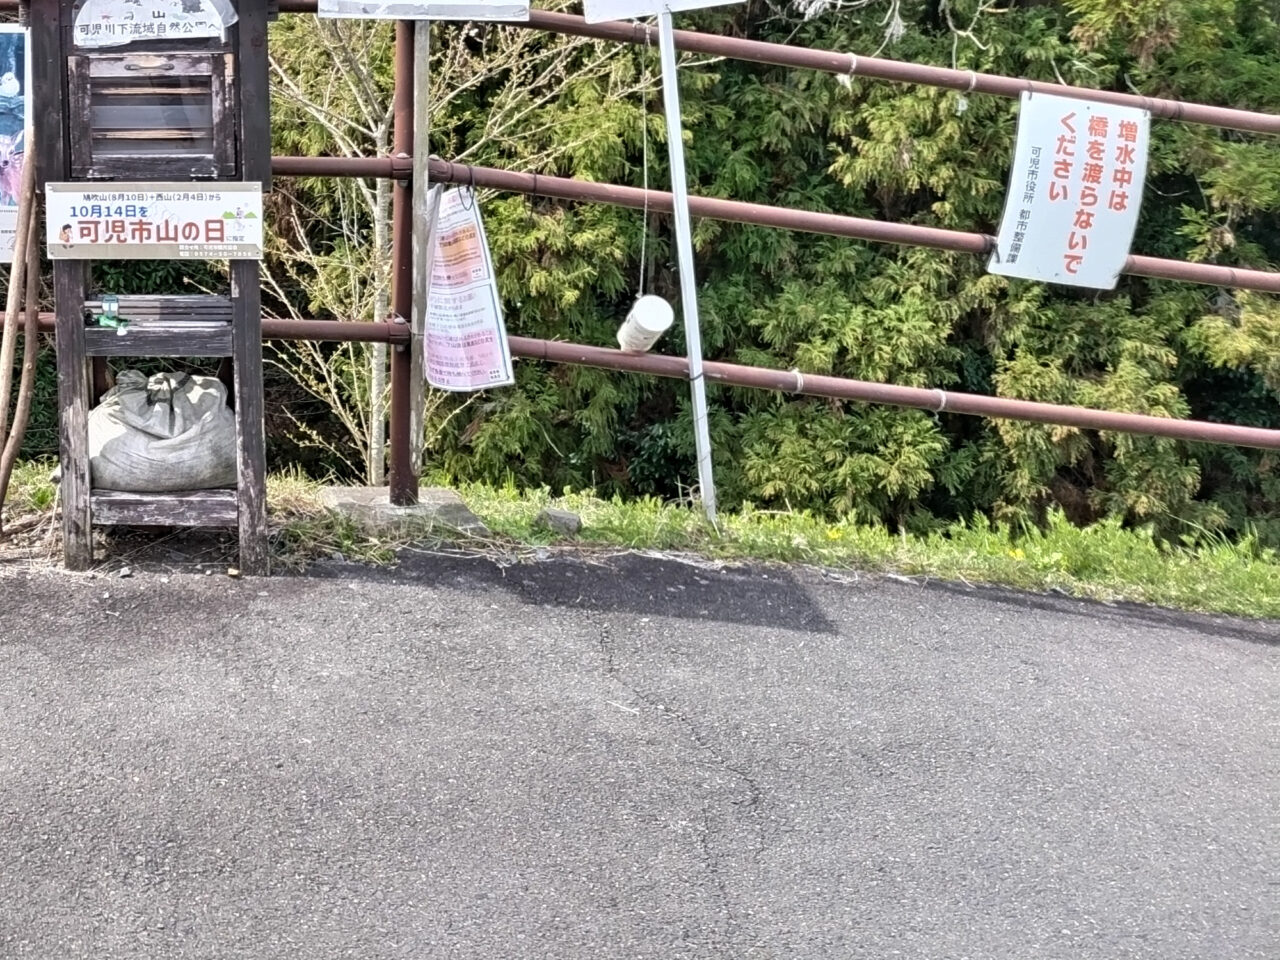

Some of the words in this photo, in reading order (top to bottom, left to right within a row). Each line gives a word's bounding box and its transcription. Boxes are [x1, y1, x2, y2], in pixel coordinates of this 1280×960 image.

[1022, 146, 1042, 205] 可児市役所
[1048, 111, 1076, 202] ください
[1108, 119, 1139, 212] 増水中は
[70, 205, 148, 218] 10月14日を
[77, 219, 225, 243] 可児市山の日
[1063, 114, 1109, 275] 橋を渡らないで
